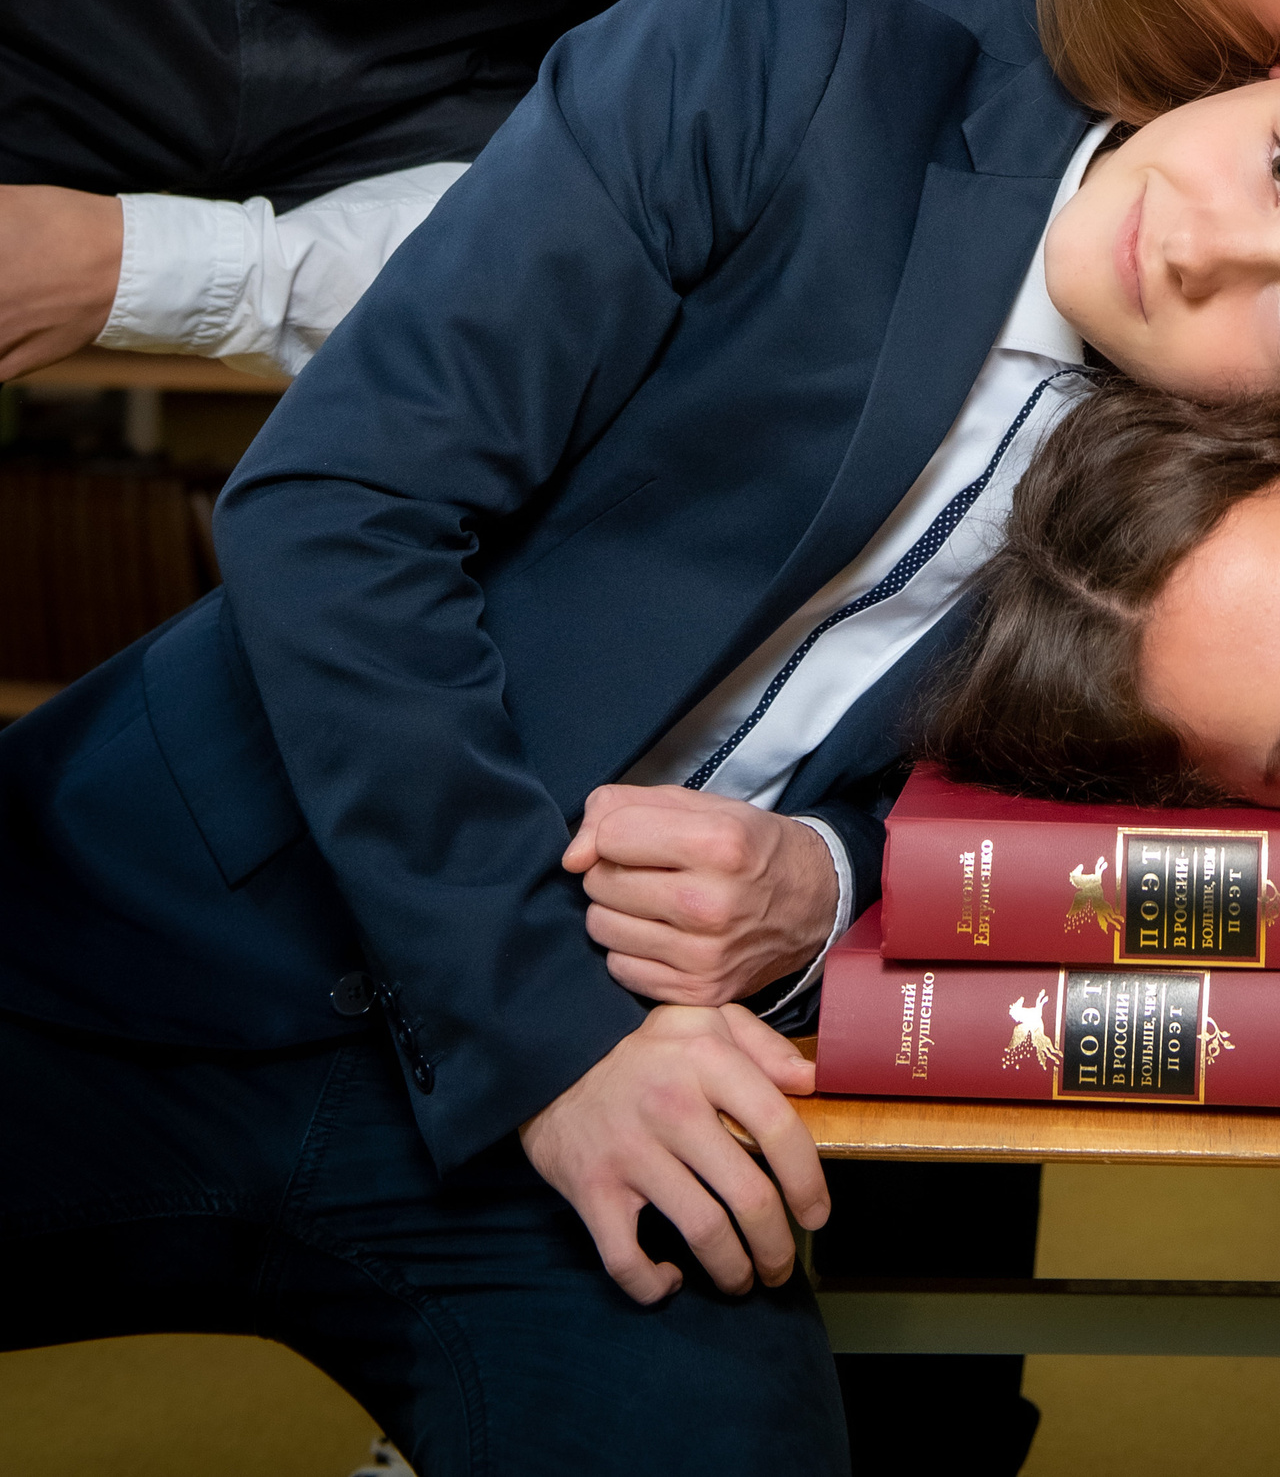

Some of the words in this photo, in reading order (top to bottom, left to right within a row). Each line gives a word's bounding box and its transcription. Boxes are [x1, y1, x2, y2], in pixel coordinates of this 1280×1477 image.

[1140, 845, 1161, 949] ПОЭТ
[1228, 868, 1242, 933] ПОЭТ
[1173, 936, 1187, 948] В
[895, 983, 917, 1066] Евгений
[912, 972, 935, 1080] Евтушенко
[1079, 980, 1103, 1084] ПОЭТ
[1144, 982, 1158, 1017] ЧЕМ
[1141, 1017, 1157, 1086] БОЛЬШЕ,
[1167, 1005, 1183, 1071] ПОЭТ
[1113, 1073, 1126, 1084] В
